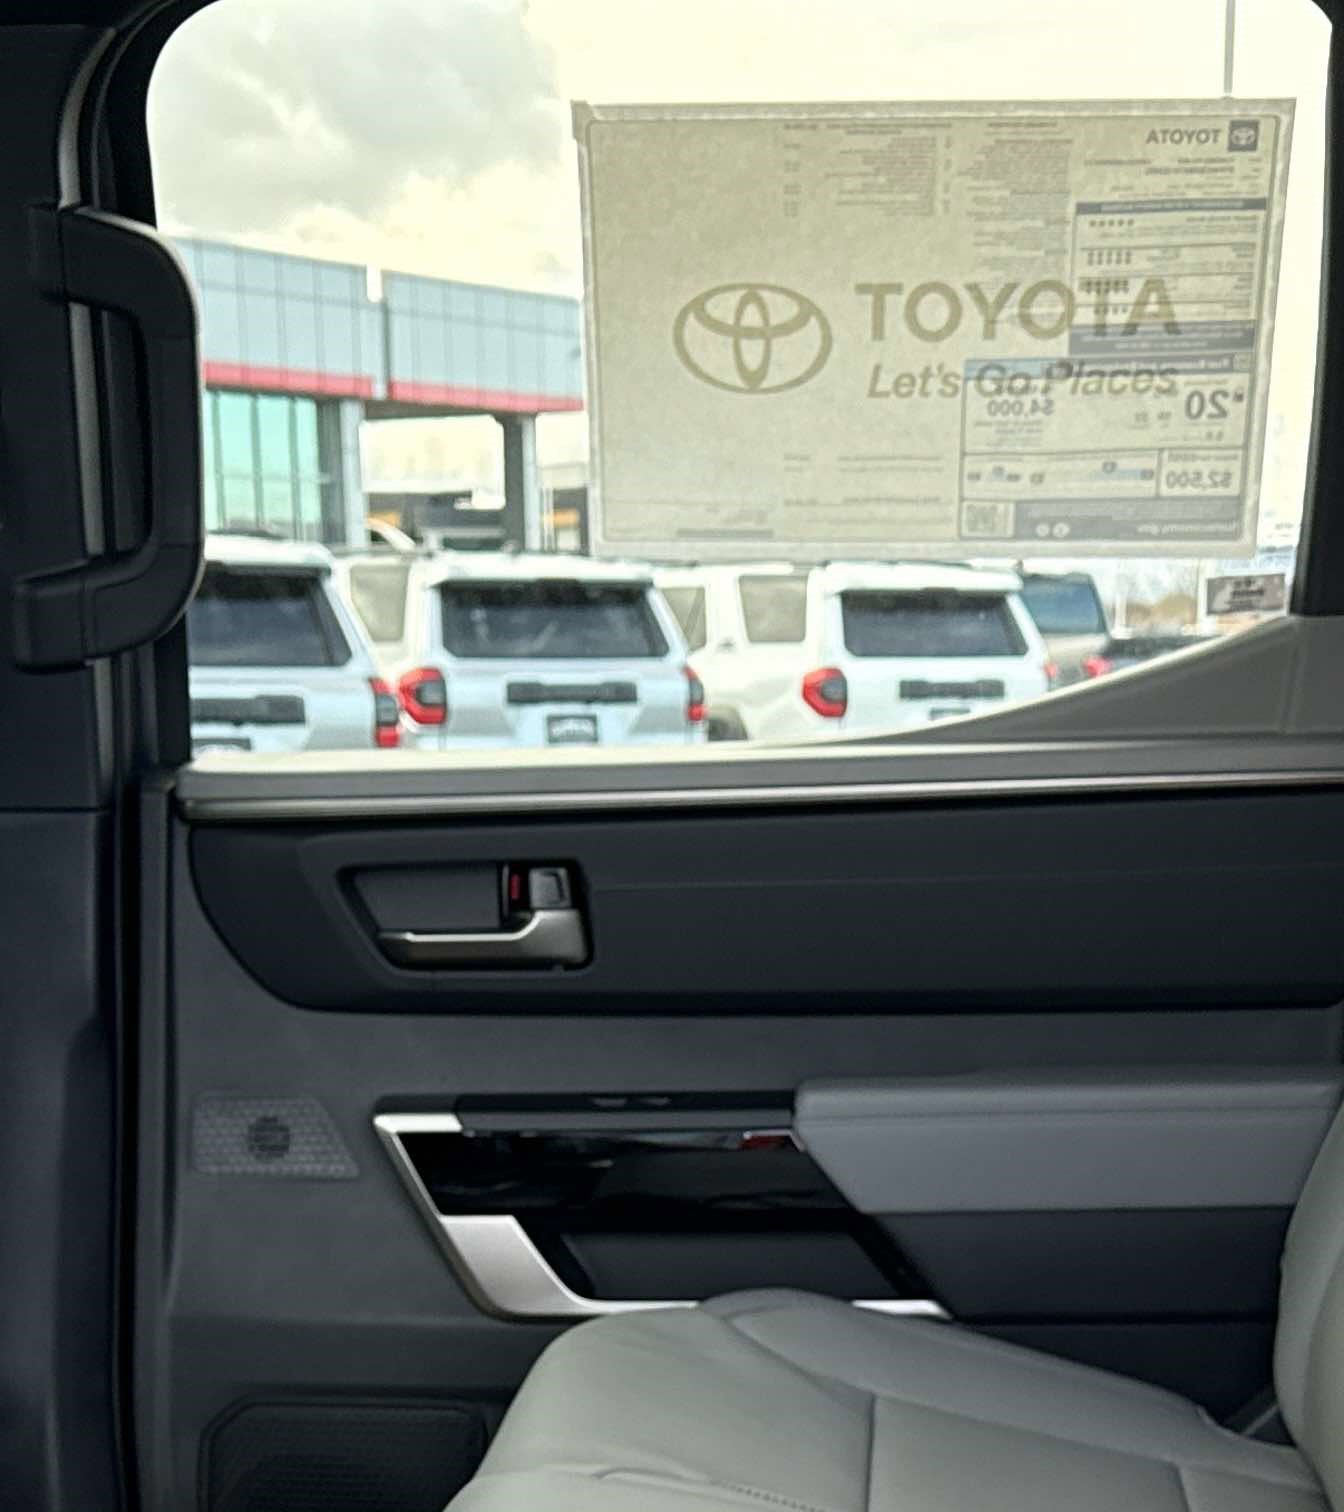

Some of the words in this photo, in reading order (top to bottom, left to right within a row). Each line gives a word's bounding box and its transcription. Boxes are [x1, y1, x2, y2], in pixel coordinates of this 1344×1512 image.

[855, 280, 1181, 343] TOYOTA
[867, 363, 961, 399] Let's
[974, 364, 1033, 398] Go
[1044, 361, 1179, 396] Places
